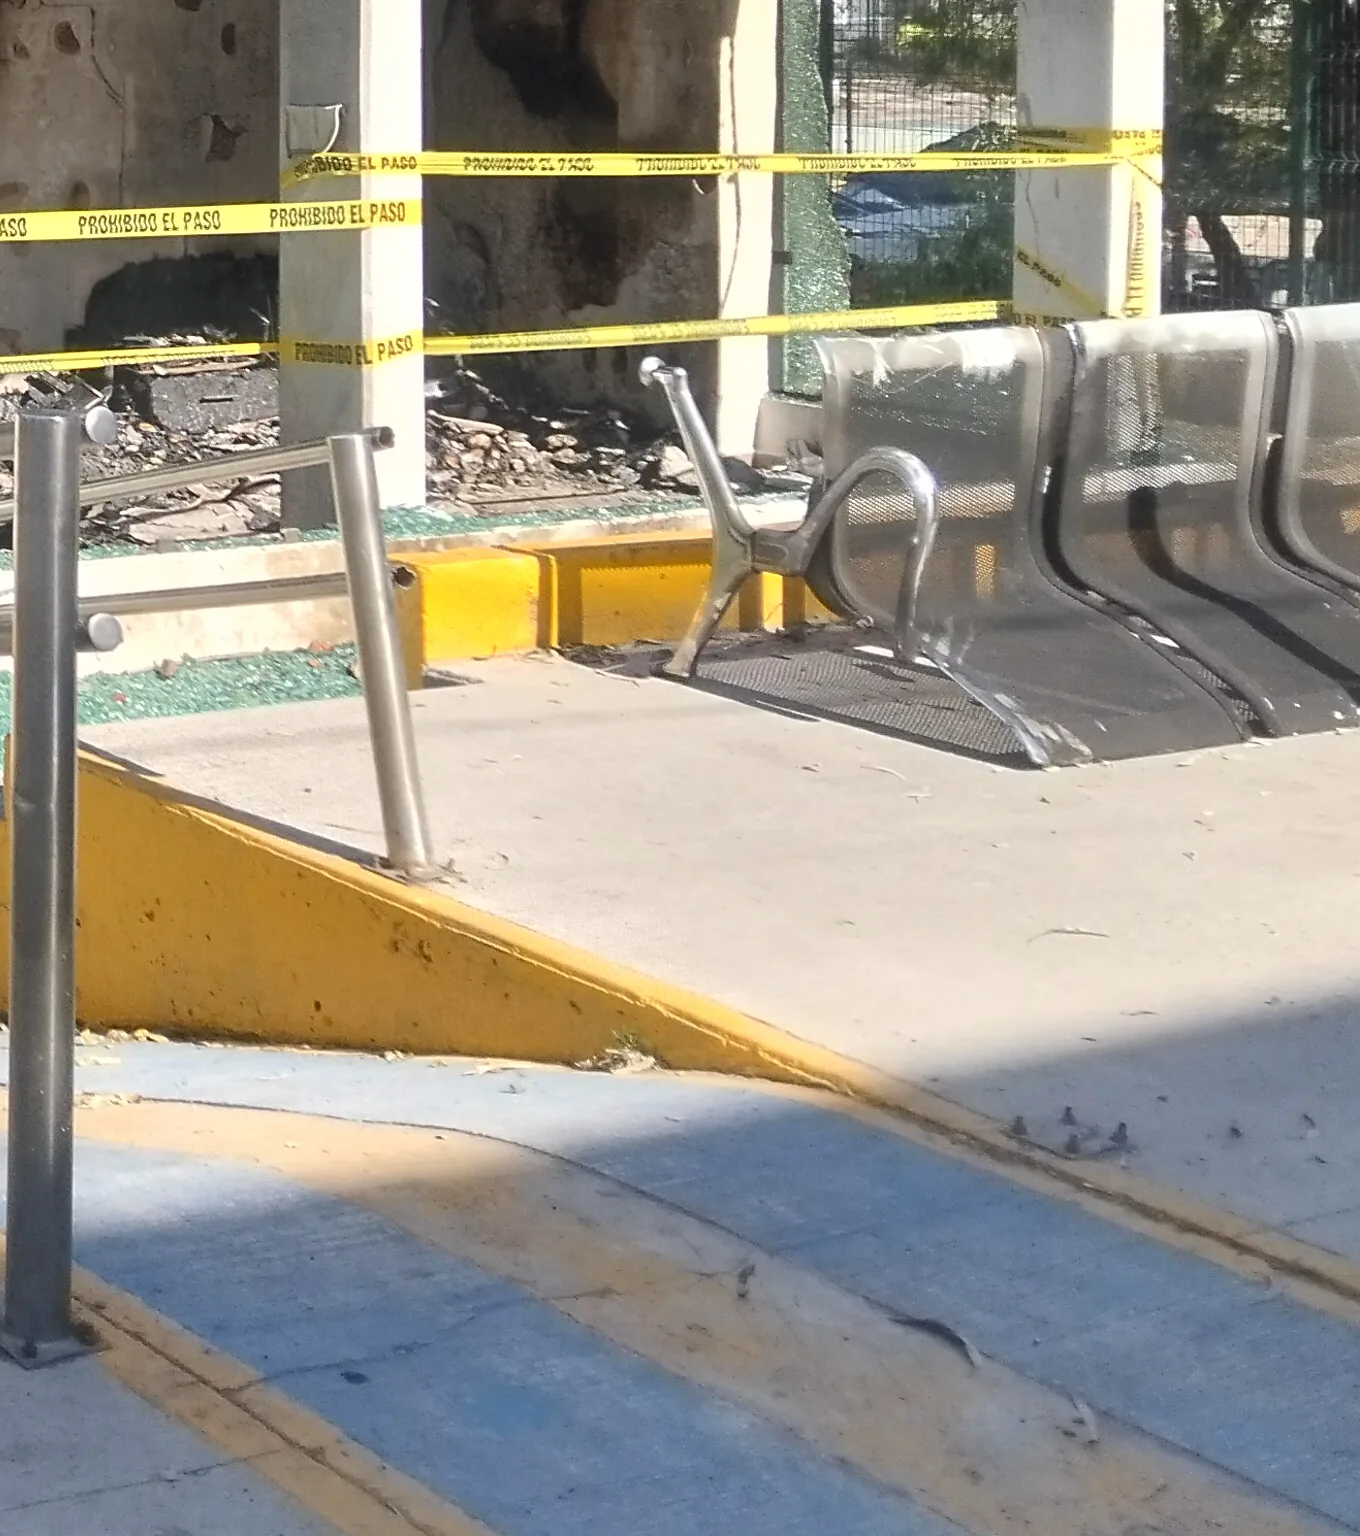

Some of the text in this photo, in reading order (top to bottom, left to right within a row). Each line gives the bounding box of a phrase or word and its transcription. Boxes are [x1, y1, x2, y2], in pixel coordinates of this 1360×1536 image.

[359, 155, 376, 170] EL
[381, 156, 417, 170] PASO
[78, 210, 221, 234] PROHIBIDO EL PASO
[270, 202, 405, 227] PROHIBIDO EL PASO
[295, 335, 414, 365] PROHIBIDO EL PASO
